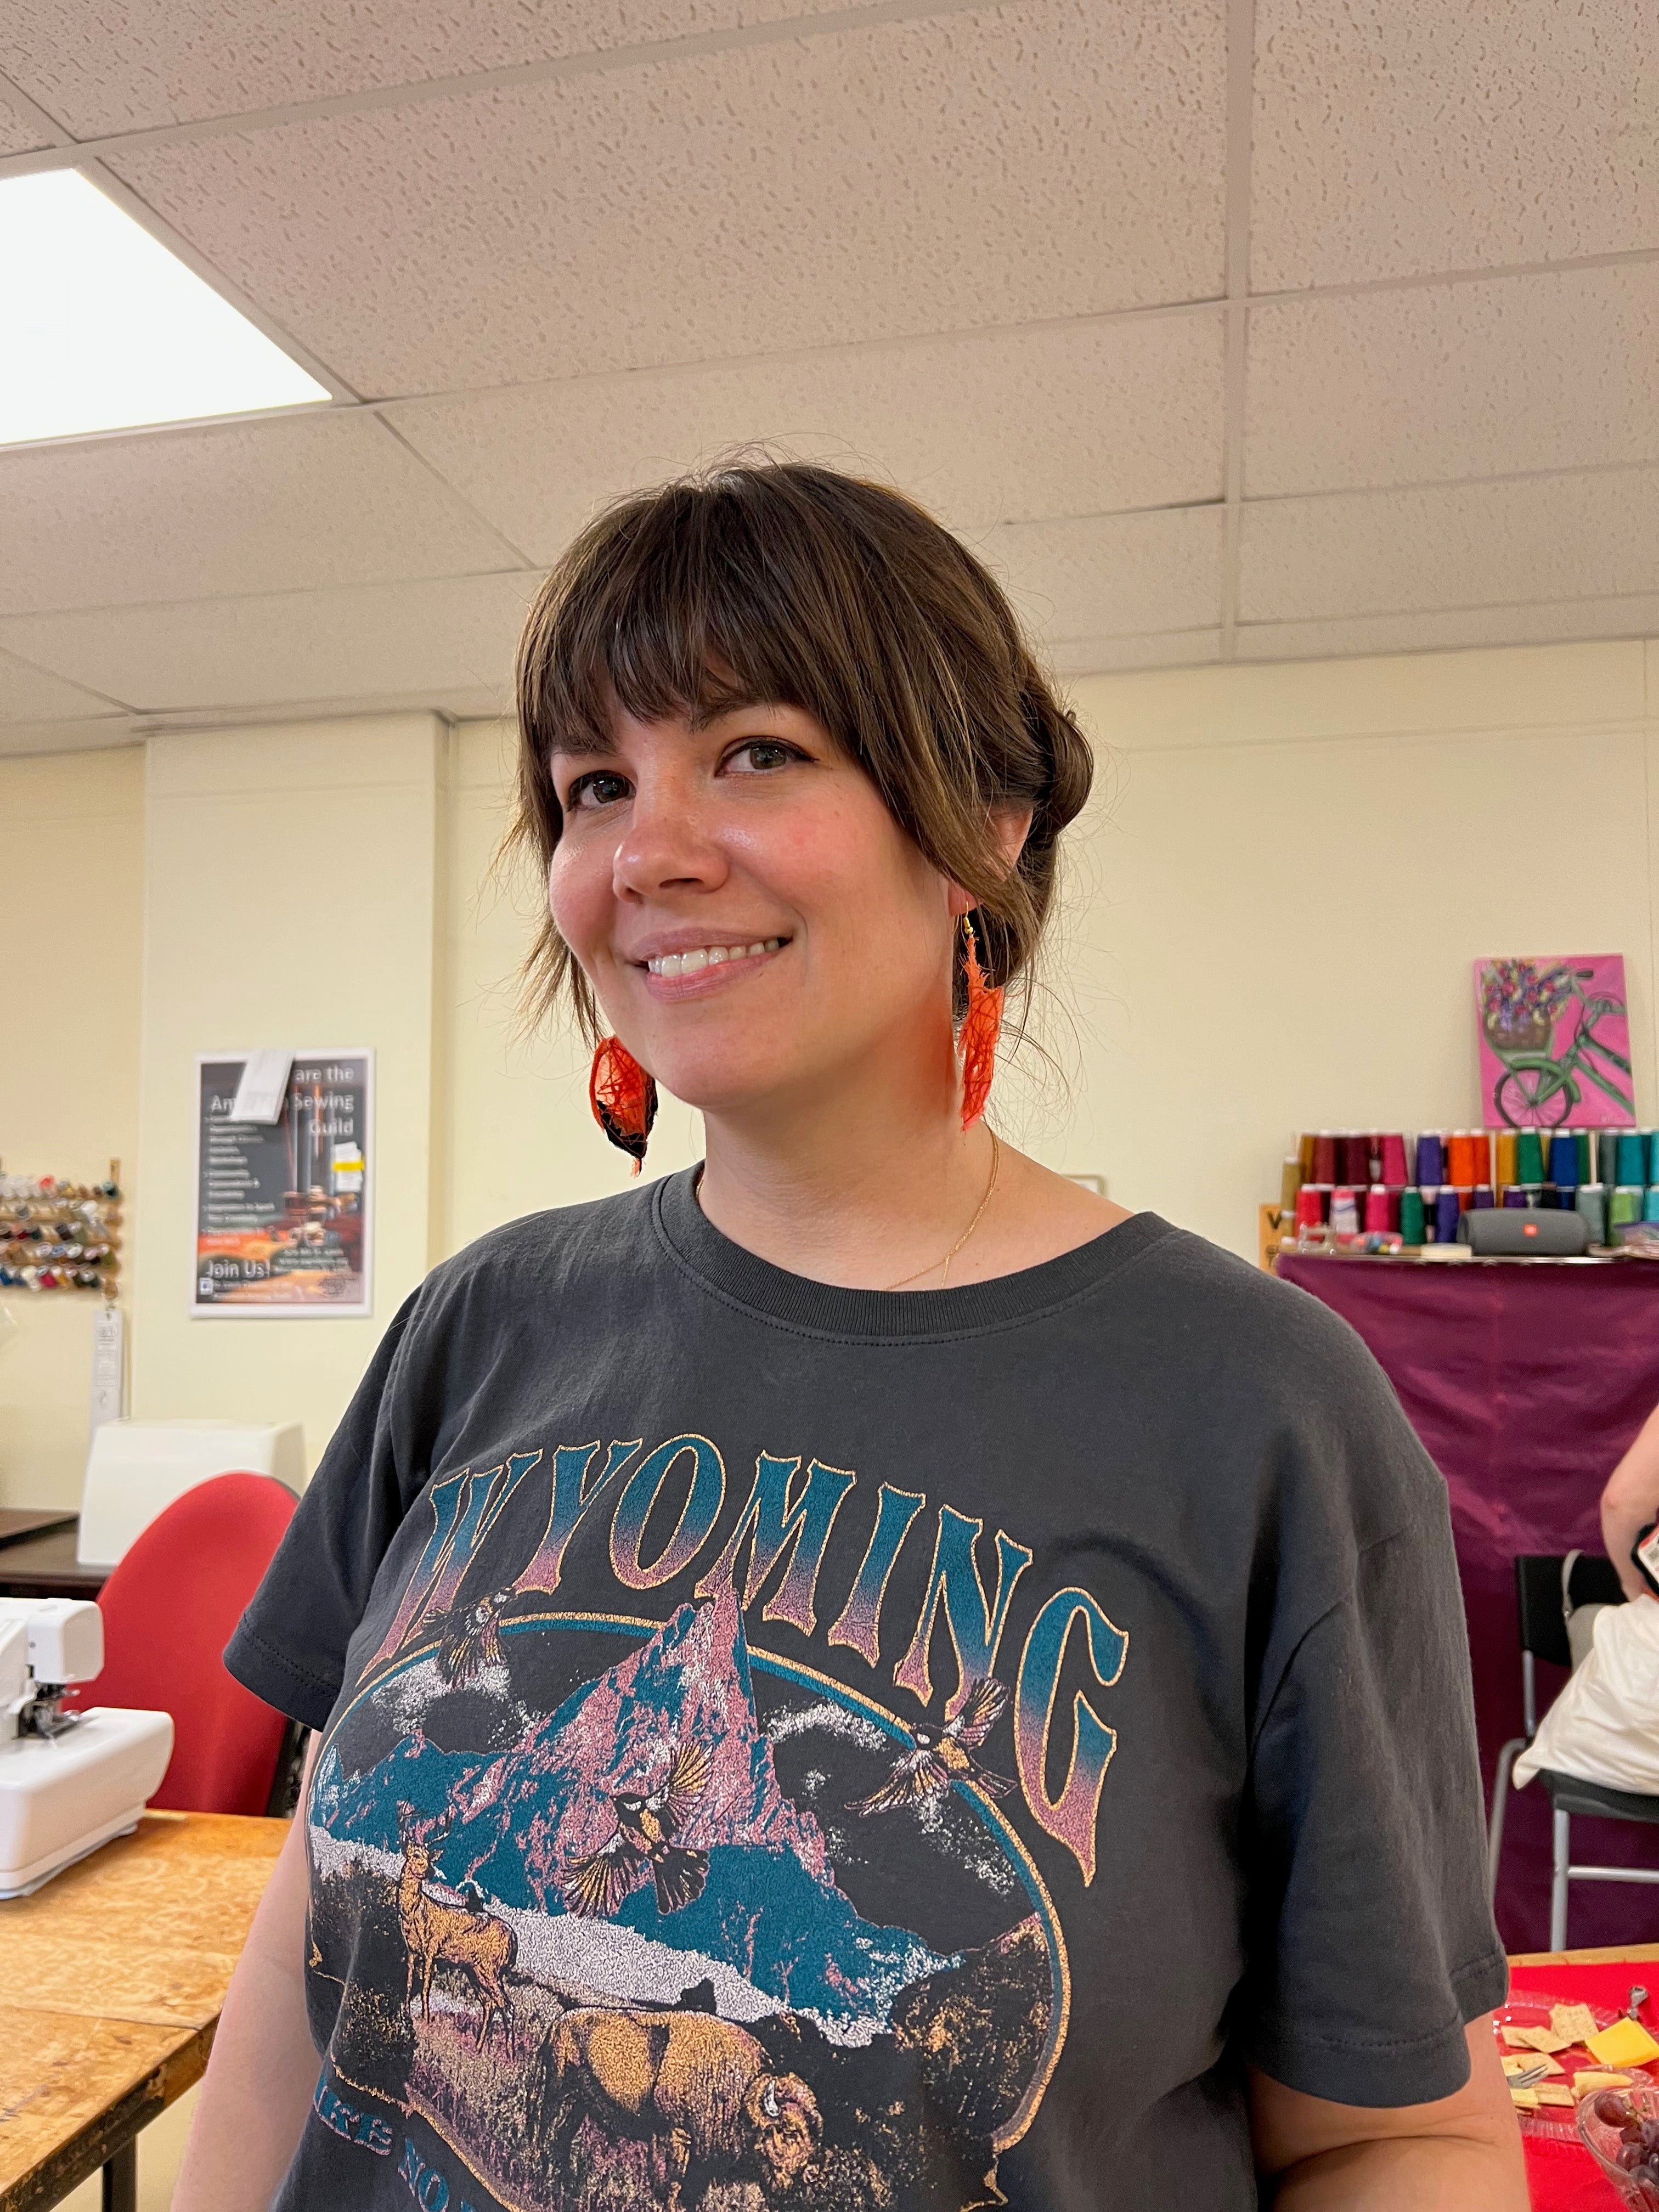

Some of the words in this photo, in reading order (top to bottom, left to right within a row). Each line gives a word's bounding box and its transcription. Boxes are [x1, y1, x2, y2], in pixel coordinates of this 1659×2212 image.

[295, 1068, 322, 1082] are
[327, 1065, 354, 1081] the
[293, 1092, 354, 1113] Sewing
[307, 1118, 354, 1136] Guild
[206, 1259, 239, 1278] Join
[244, 1259, 270, 1278] Us!
[356, 1433, 1130, 1888] WYOMING
